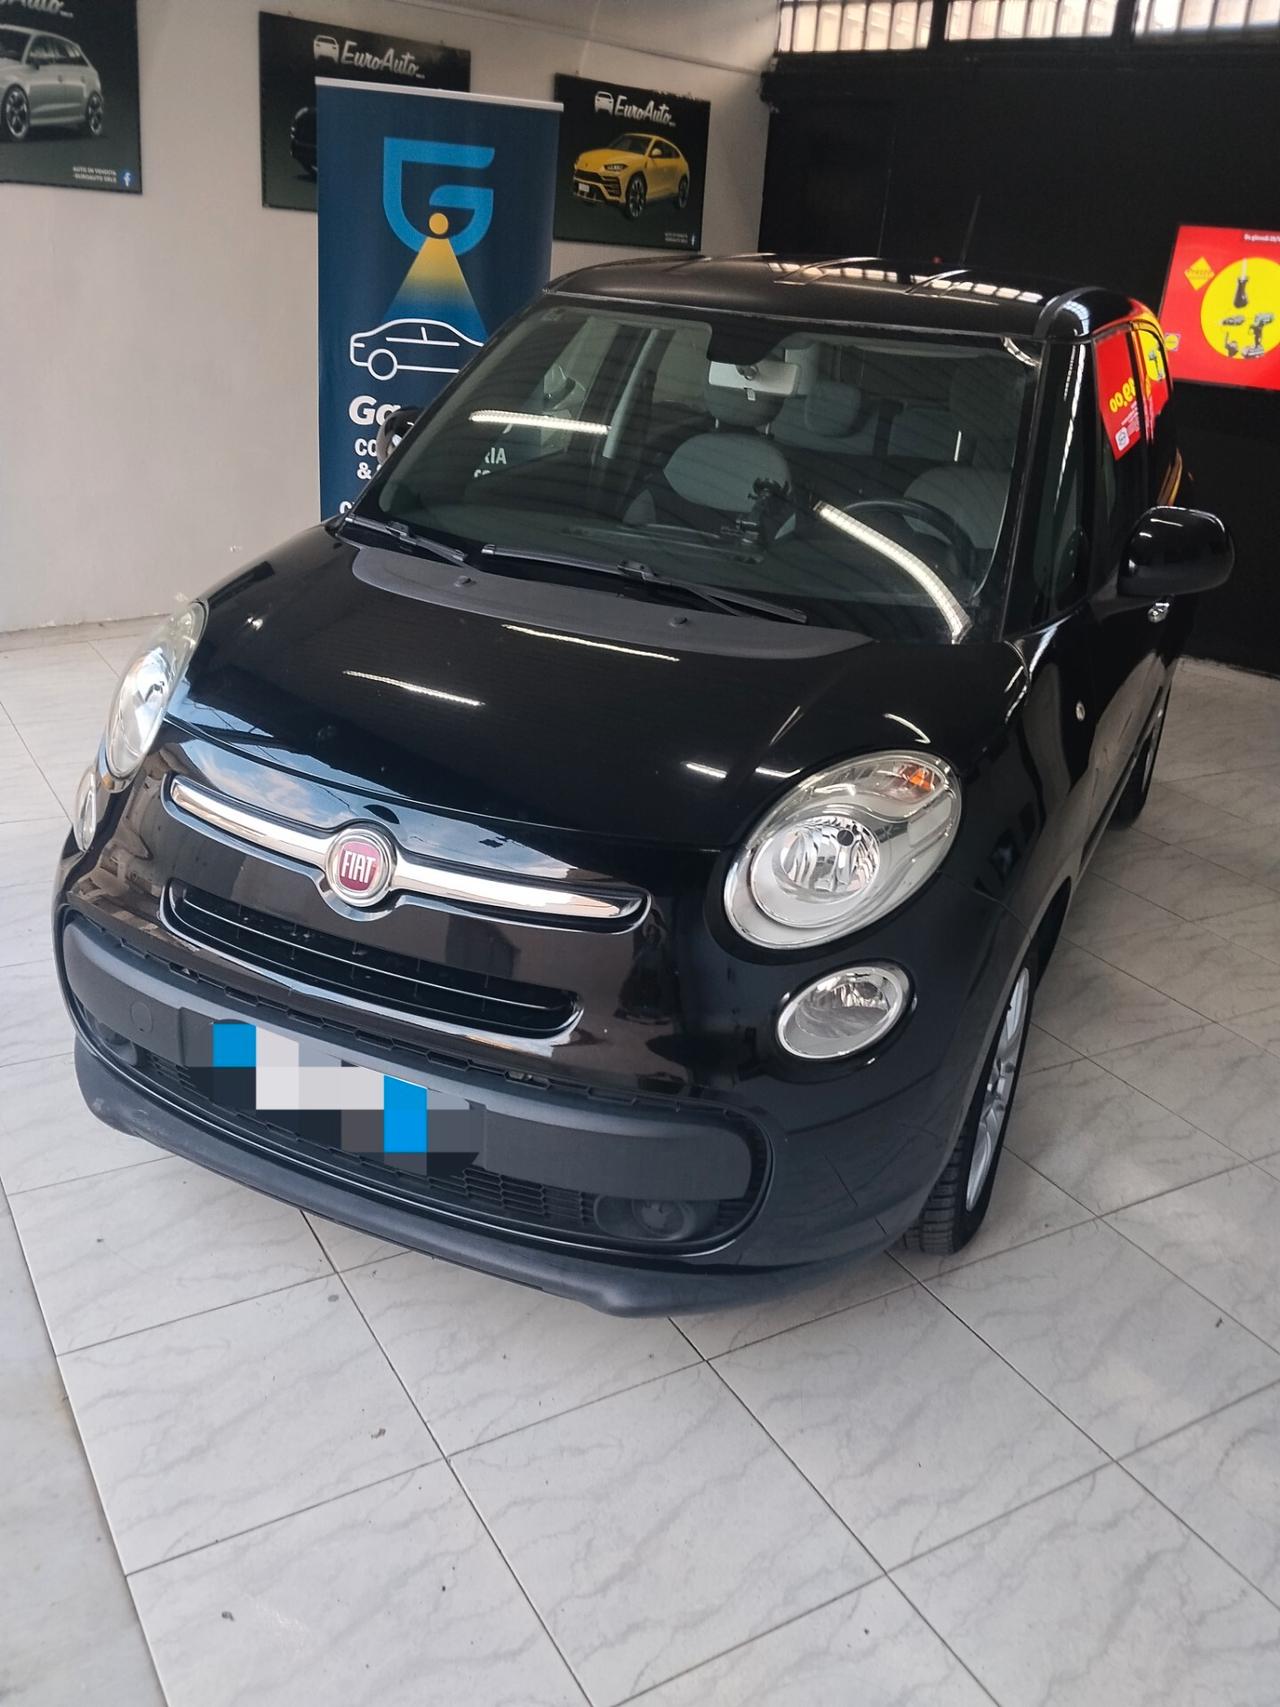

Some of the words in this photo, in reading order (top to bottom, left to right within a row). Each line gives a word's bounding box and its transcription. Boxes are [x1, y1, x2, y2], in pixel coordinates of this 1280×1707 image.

[340, 40, 419, 76] EuroAuto
[614, 95, 672, 124] EuroAuto
[356, 462, 372, 479] &
[341, 850, 376, 884] FIAT
